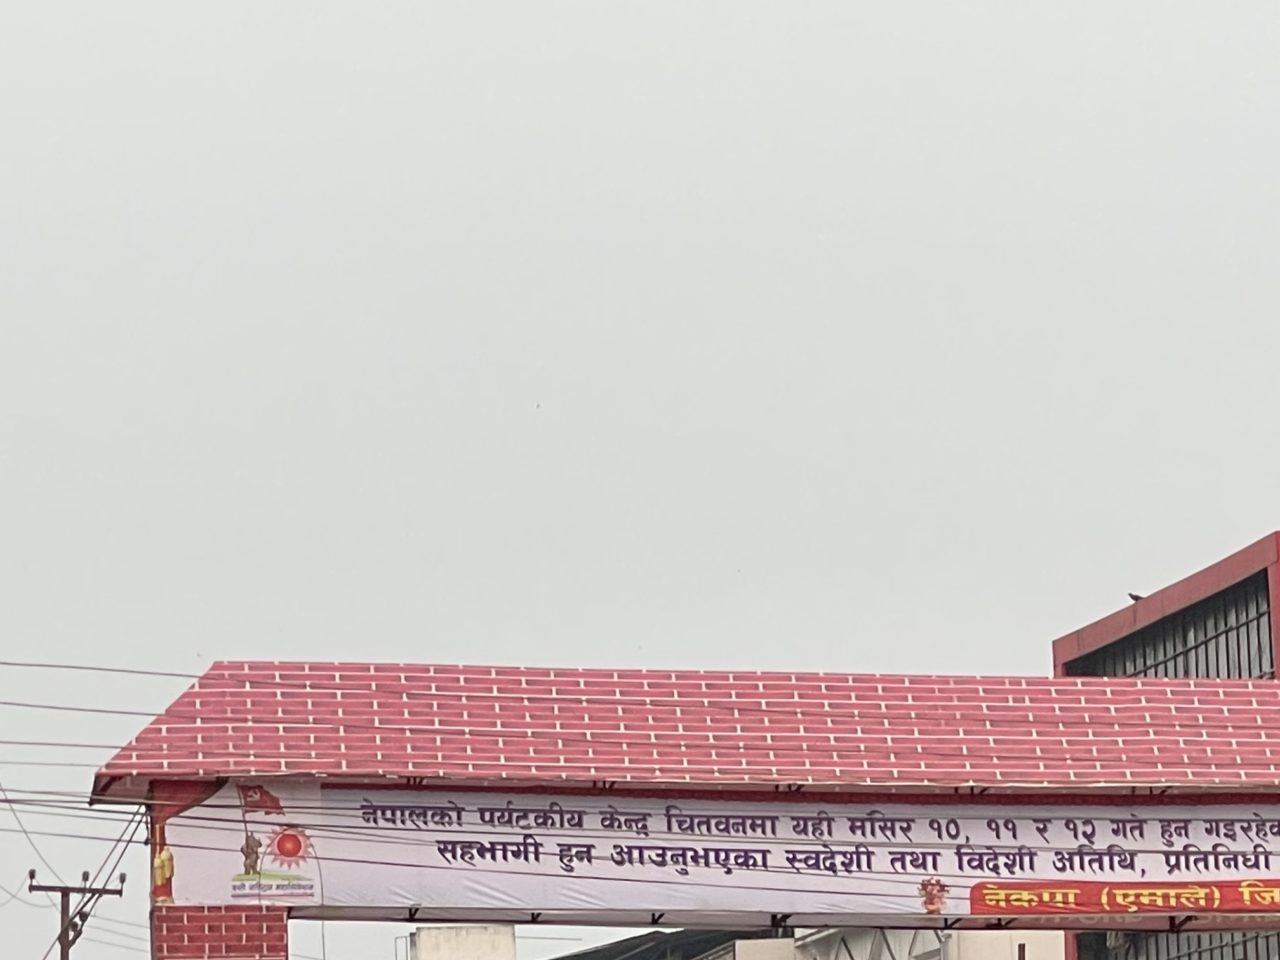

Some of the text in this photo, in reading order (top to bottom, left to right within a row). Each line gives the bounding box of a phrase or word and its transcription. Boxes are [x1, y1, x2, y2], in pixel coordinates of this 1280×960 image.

[361, 798, 465, 829] नेपालको
[478, 801, 588, 829] पर्यटकीय
[599, 804, 653, 836] केन्द्र
[665, 805, 780, 836] चितवनमा
[790, 810, 835, 843] यही
[987, 818, 1018, 841] ११
[1032, 818, 1052, 844] र
[1064, 819, 1097, 845] १२
[1111, 813, 1147, 842] गते
[1158, 818, 1192, 847] हुन
[435, 833, 543, 867] सहभागी
[556, 843, 596, 873] हुन
[610, 845, 772, 876] आउनुभएका
[785, 844, 874, 875] स्वदेशी
[889, 852, 942, 873] तथा
[954, 844, 1037, 876] विदेशी
[982, 884, 1080, 908] नेकपा
